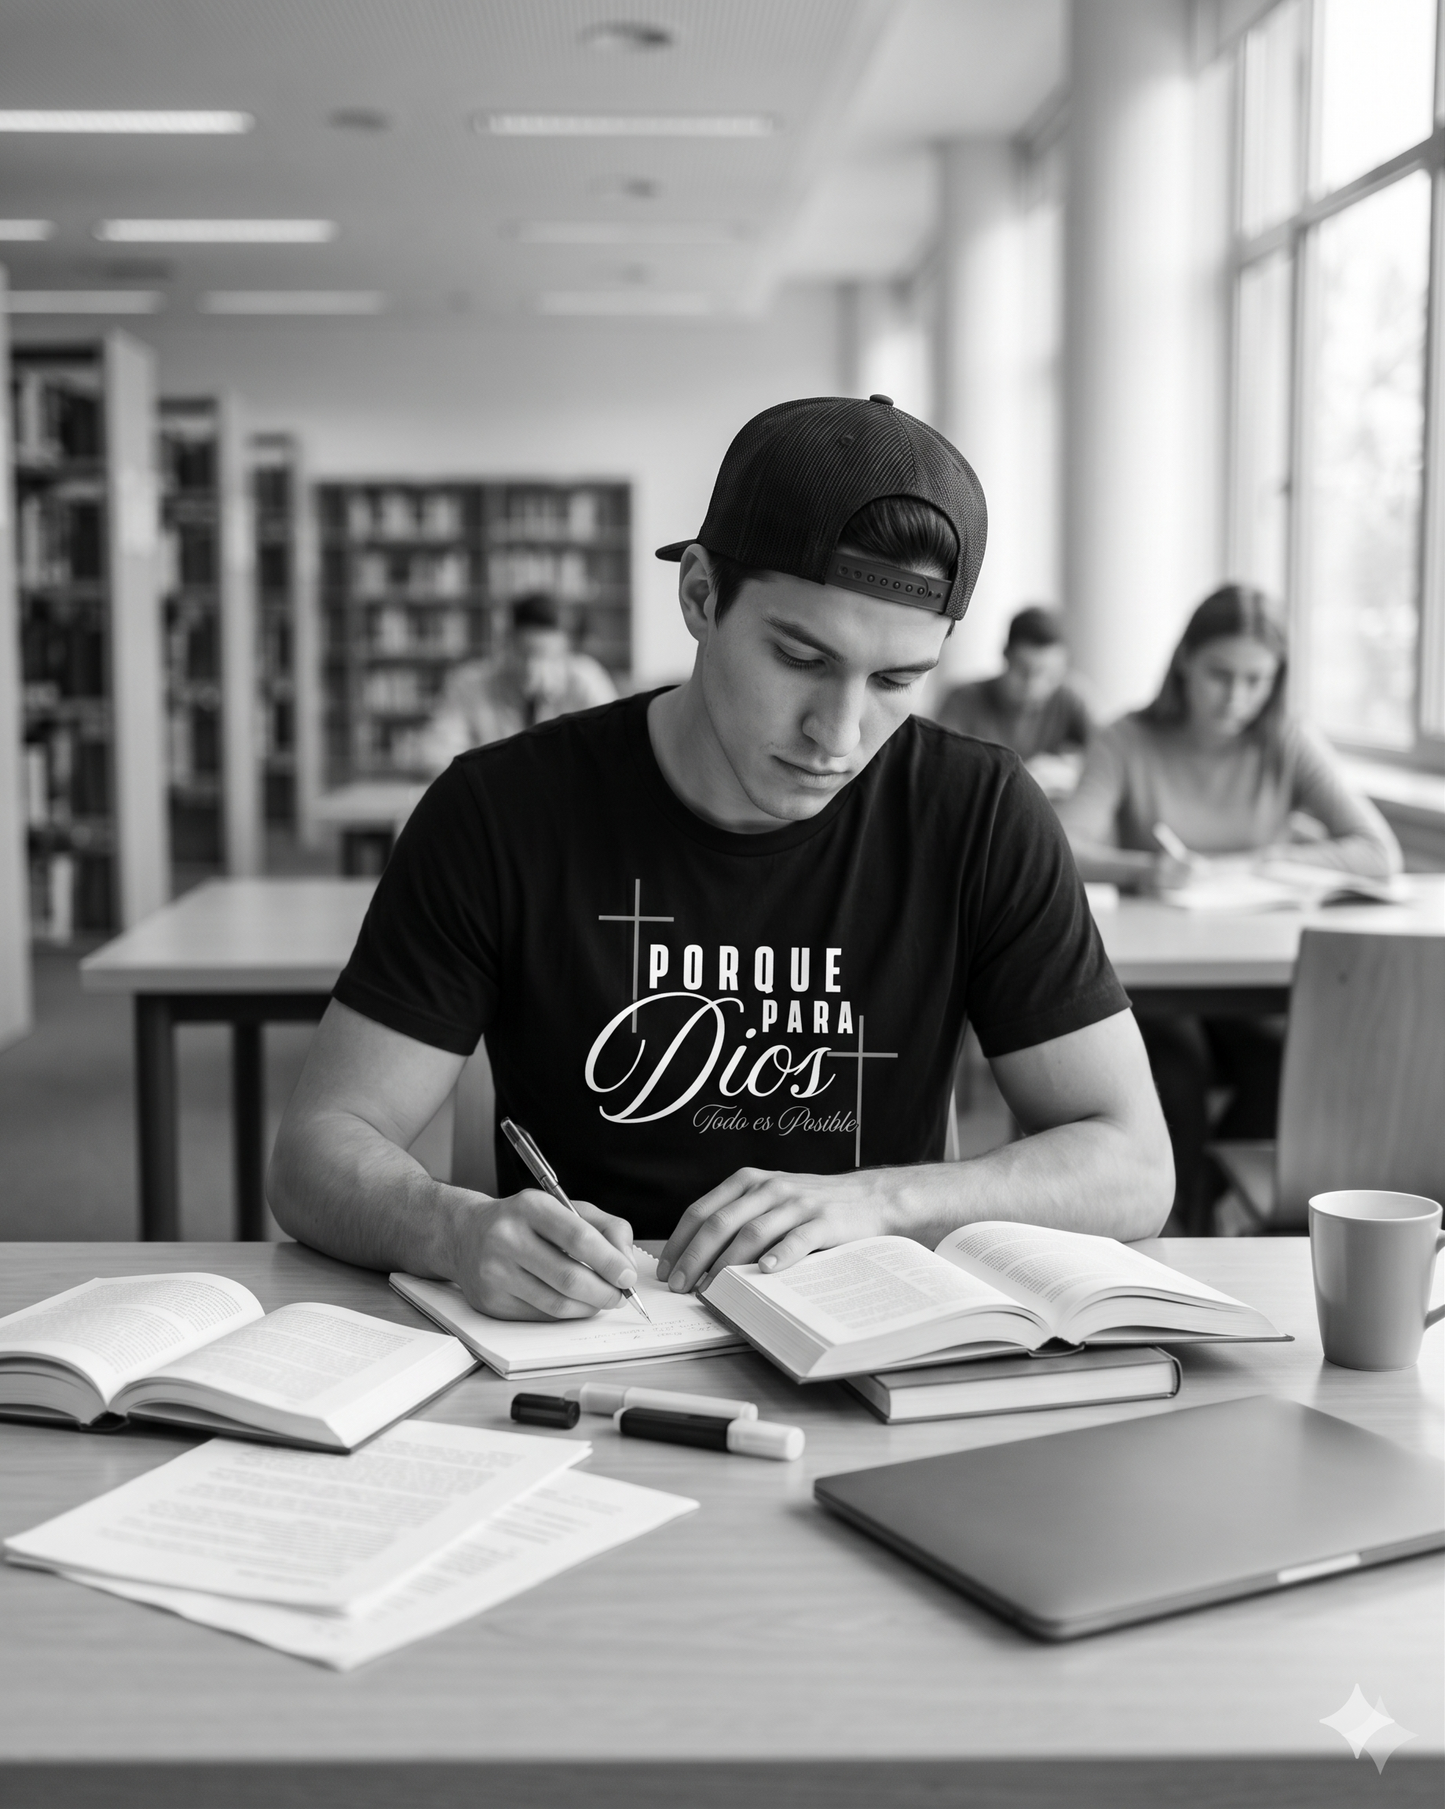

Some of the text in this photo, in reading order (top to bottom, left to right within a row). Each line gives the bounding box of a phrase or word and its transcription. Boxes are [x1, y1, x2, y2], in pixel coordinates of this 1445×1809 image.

[649, 944, 842, 994] PORQUE
[762, 999, 854, 1034] PARA
[584, 991, 836, 1124] Dios
[692, 1104, 859, 1136] Todo es Posible
